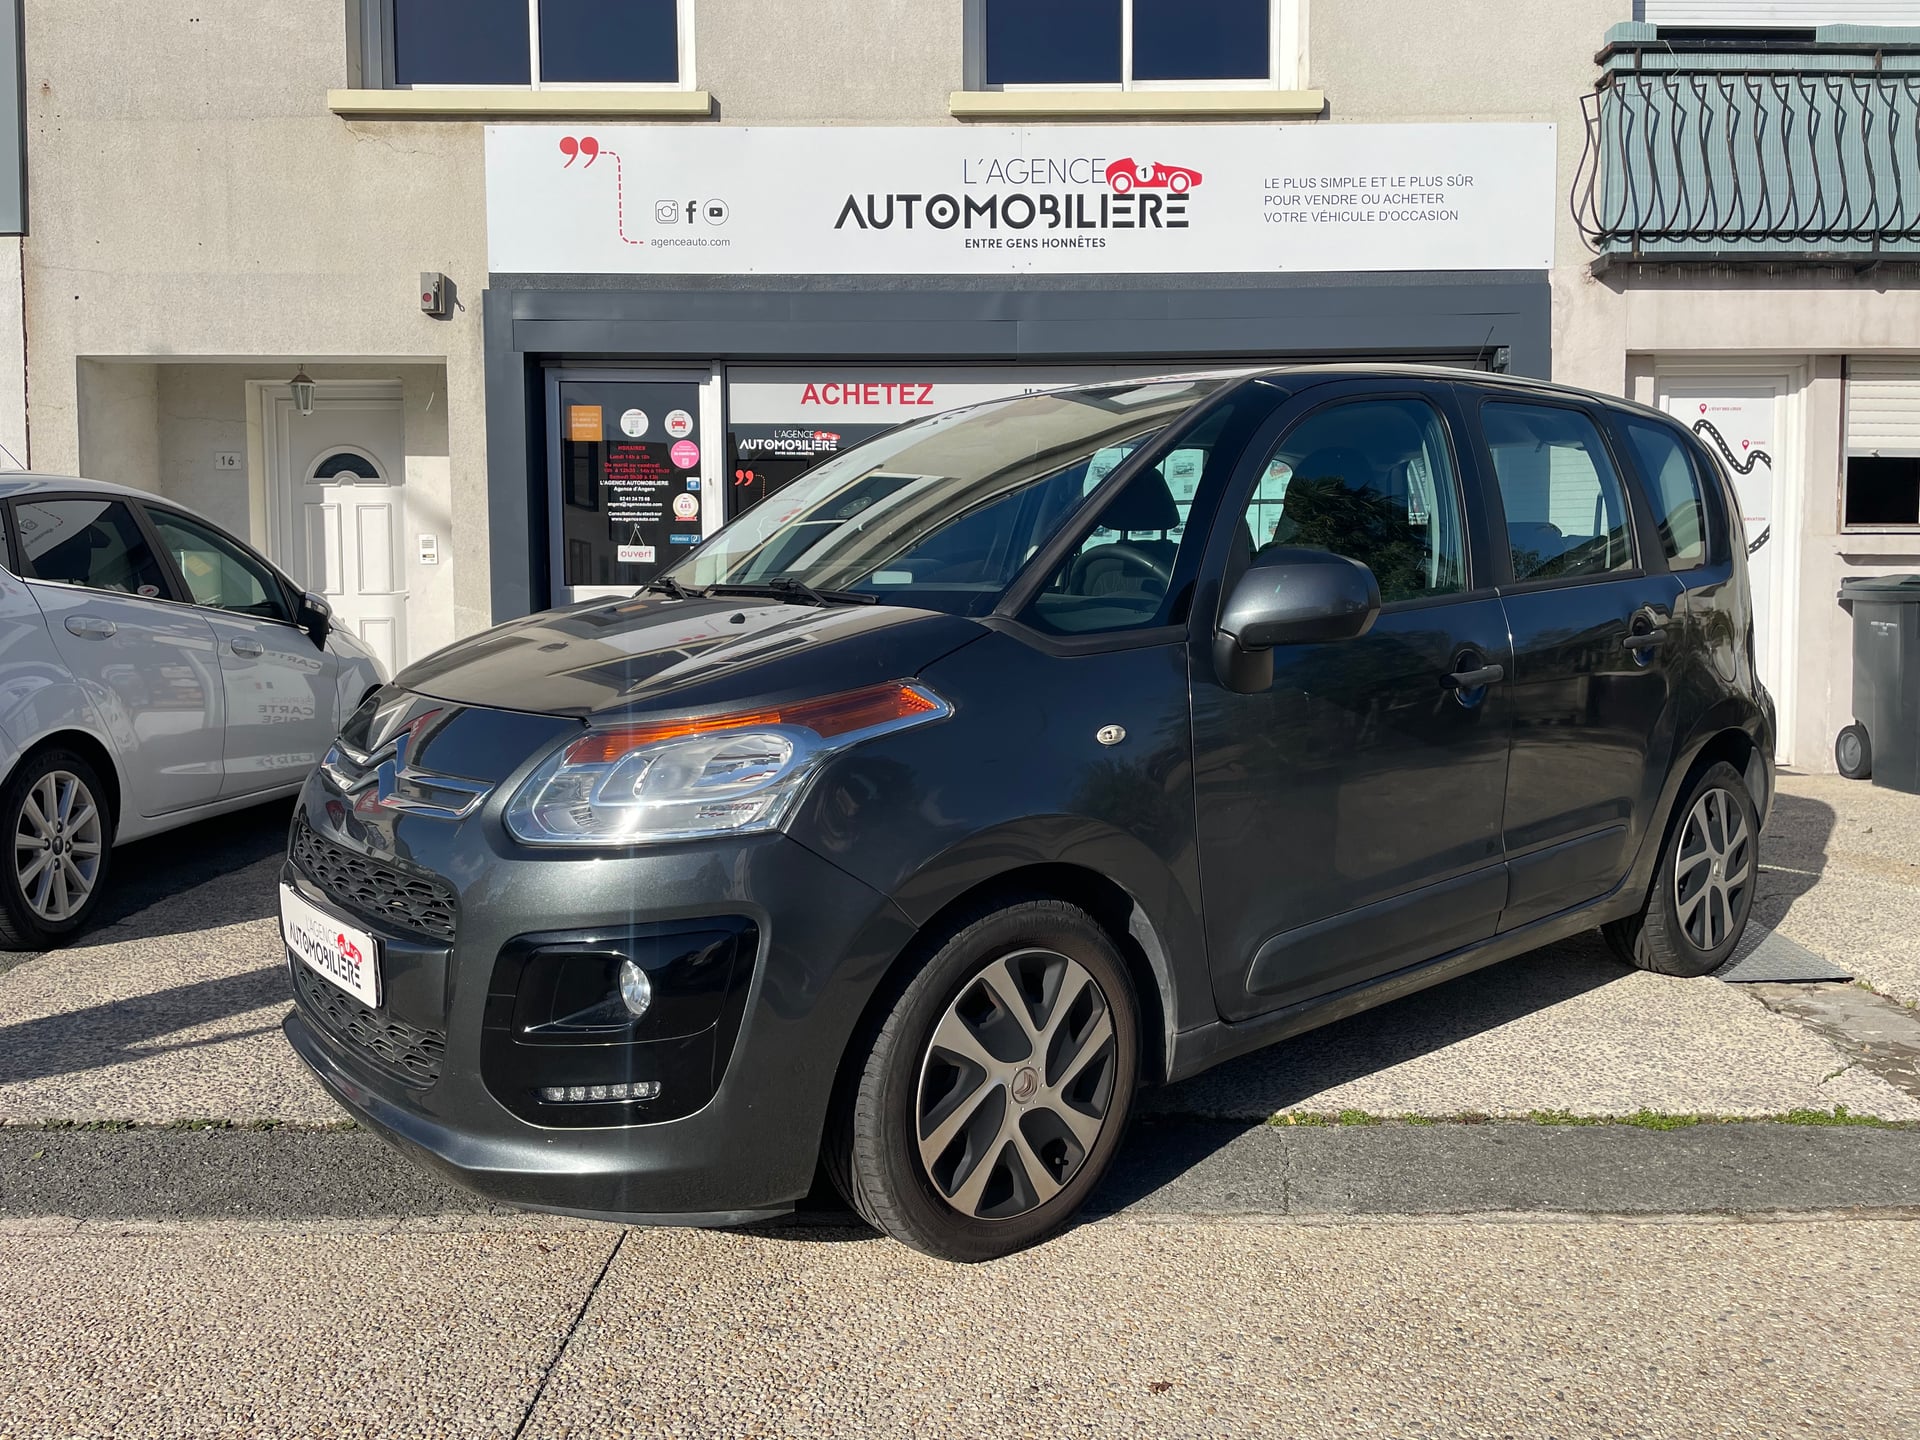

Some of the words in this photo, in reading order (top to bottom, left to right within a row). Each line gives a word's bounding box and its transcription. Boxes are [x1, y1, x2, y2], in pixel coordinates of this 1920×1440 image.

[963, 157, 1107, 185] L'AGENCE
[1264, 177, 1280, 189] LE
[1283, 177, 1317, 189] PLUS
[1320, 176, 1368, 188] SIMPLE
[1370, 176, 1388, 188] ET
[1390, 175, 1406, 187] LE
[1409, 175, 1443, 187] PLUS
[1446, 173, 1474, 187] SÛR
[1264, 194, 1301, 206] POUR
[1304, 194, 1358, 206] VENDRE
[1361, 193, 1381, 205] OU
[1383, 193, 1445, 205] ACHETER
[1263, 211, 1308, 223] VOTRE
[1311, 209, 1375, 222] VÉHICULE
[1379, 209, 1459, 222] D'OCCASION
[650, 237, 731, 249] agenceauto.com
[964, 238, 1004, 249] ENTRE
[1006, 238, 1039, 249] GENS
[1041, 234, 1107, 249] HONNÊTES
[800, 383, 935, 405] ACHETEZ
[774, 429, 815, 439] L'AGENCE
[220, 455, 235, 467] 16
[620, 550, 652, 558] ouvert
